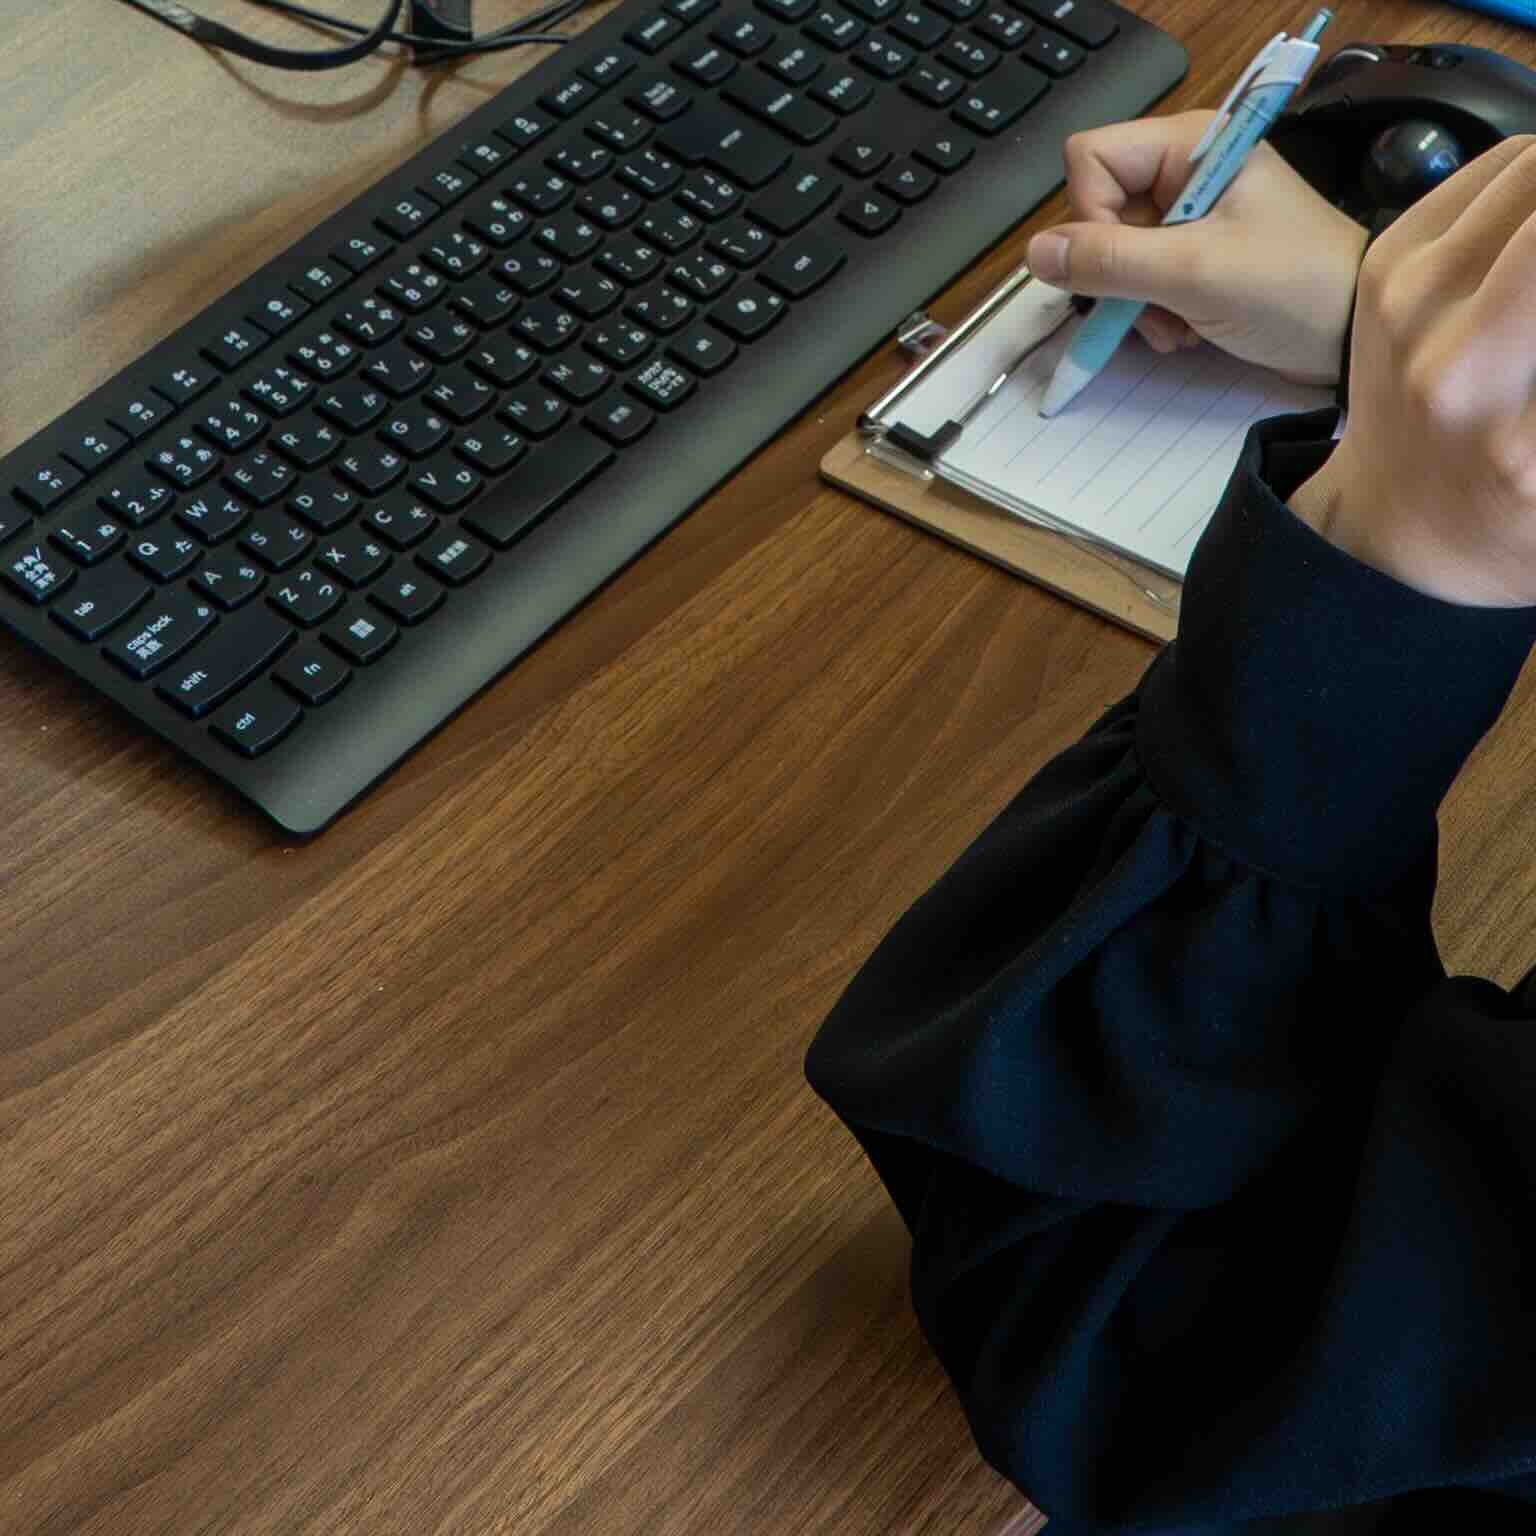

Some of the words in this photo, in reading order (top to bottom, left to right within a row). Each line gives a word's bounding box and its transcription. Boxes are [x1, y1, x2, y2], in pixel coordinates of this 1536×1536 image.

[490, 224, 505, 234] 0
[542, 229, 555, 240] P
[448, 257, 462, 267] 9
[504, 260, 520, 272] O
[405, 289, 421, 300] 8
[563, 288, 581, 297] L
[360, 323, 374, 334] 7
[522, 317, 540, 330] K
[417, 327, 434, 339] U
[318, 358, 331, 368] 6
[482, 353, 494, 364] J
[373, 361, 389, 373] Y
[552, 365, 572, 380] M
[272, 392, 287, 404] 5
[434, 386, 453, 400] H
[327, 397, 342, 408] T
[509, 402, 527, 415] N
[226, 428, 239, 439] 4
[392, 422, 408, 434] G
[282, 434, 299, 446] R
[464, 439, 482, 451] B
[176, 464, 192, 476] 3
[345, 458, 357, 471] F
[235, 469, 252, 482] E
[420, 473, 437, 485] V
[296, 495, 313, 507] D
[128, 502, 144, 514] 2
[186, 501, 208, 517] W
[375, 510, 392, 523] C
[251, 532, 267, 545] S
[77, 541, 91, 550] 1
[138, 543, 158, 555] Q
[326, 548, 345, 563] X
[204, 572, 222, 584] A
[280, 588, 298, 602] Z
[74, 602, 94, 616] tab
[127, 630, 155, 654] caps
[147, 616, 172, 634] lock
[304, 664, 320, 675] fn
[182, 672, 207, 690] shift
[236, 713, 255, 729] ctrl
